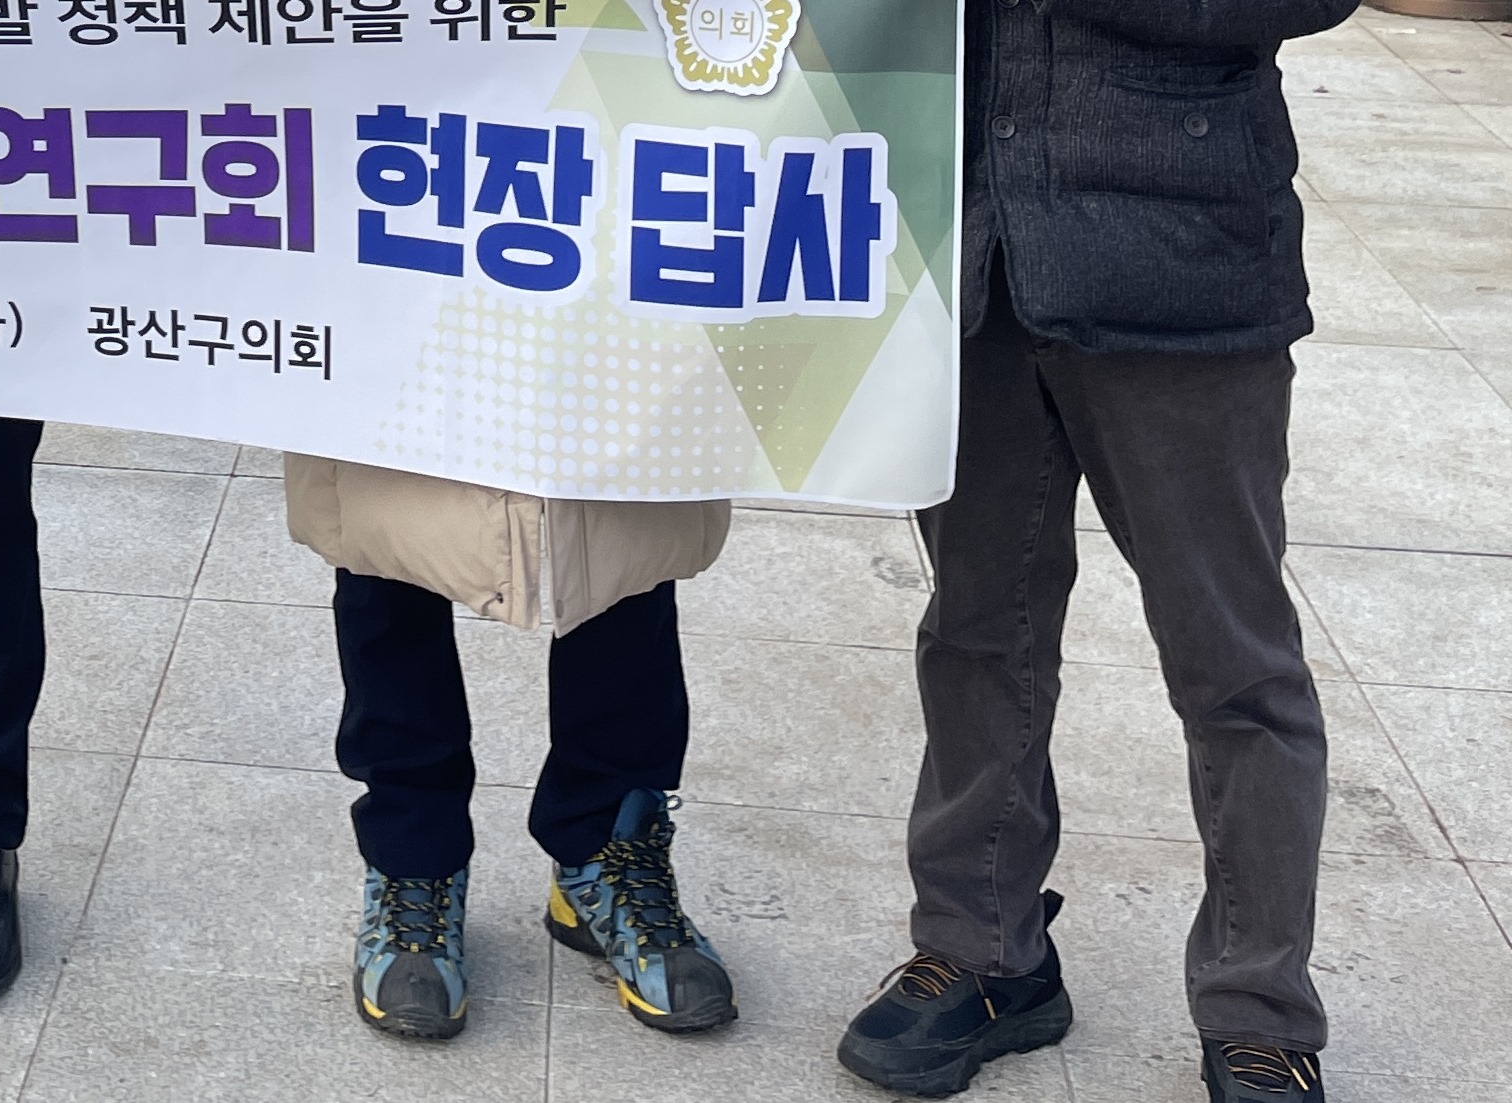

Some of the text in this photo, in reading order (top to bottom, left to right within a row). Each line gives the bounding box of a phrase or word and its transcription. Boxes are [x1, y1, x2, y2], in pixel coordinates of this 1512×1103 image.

[698, 8, 754, 43] 의회
[354, 104, 594, 293] 현장
[628, 140, 881, 310] 답사
[87, 305, 333, 380] 광산구의회
